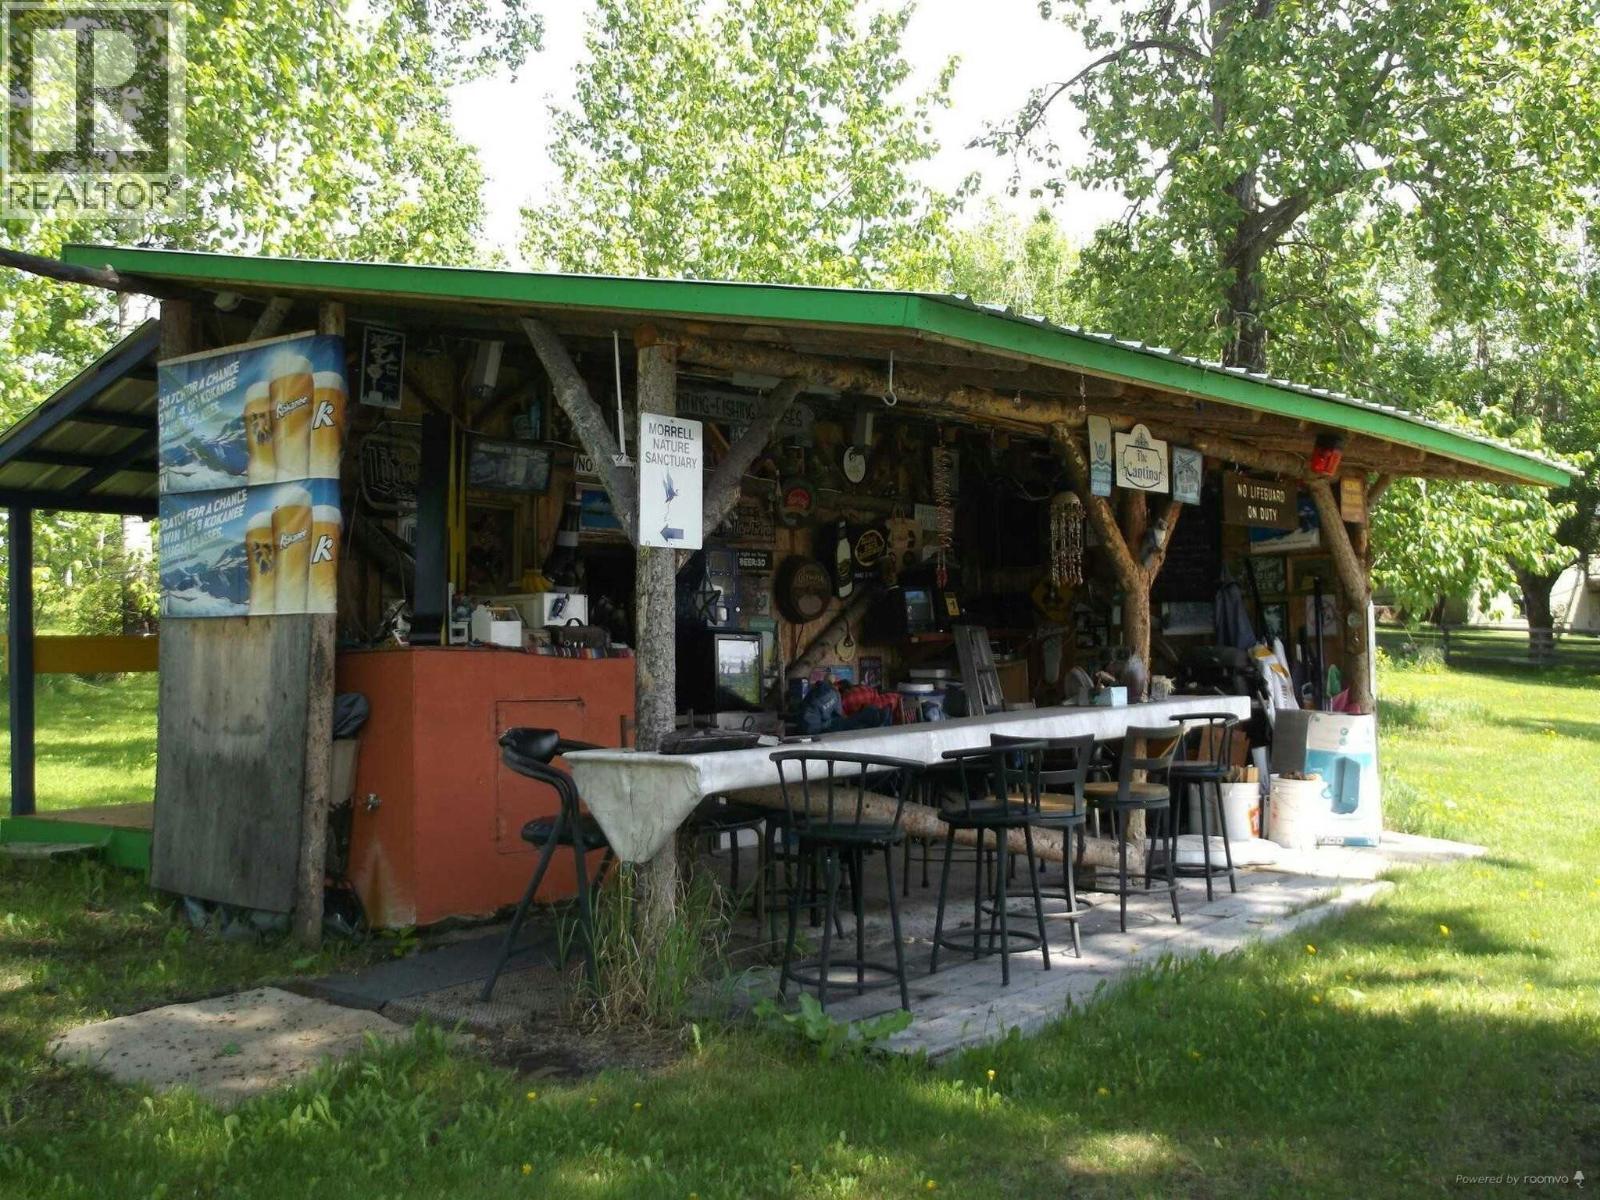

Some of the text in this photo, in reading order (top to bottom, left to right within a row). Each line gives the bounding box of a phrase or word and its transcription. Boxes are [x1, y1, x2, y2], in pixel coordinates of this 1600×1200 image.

[206, 360, 240, 386] CHANCE
[313, 400, 335, 430] K
[648, 422, 694, 440] MORRELL
[653, 438, 690, 454] NATURE
[645, 451, 697, 469] SANCTUARY
[1237, 484, 1286, 503] NO LIFEGUARD
[186, 505, 206, 521] FOR
[205, 503, 212, 515] A
[213, 489, 248, 512] CHANCE
[1247, 505, 1279, 521] ON DUTY
[203, 504, 246, 530] KOKANEE
[312, 534, 334, 564] K
